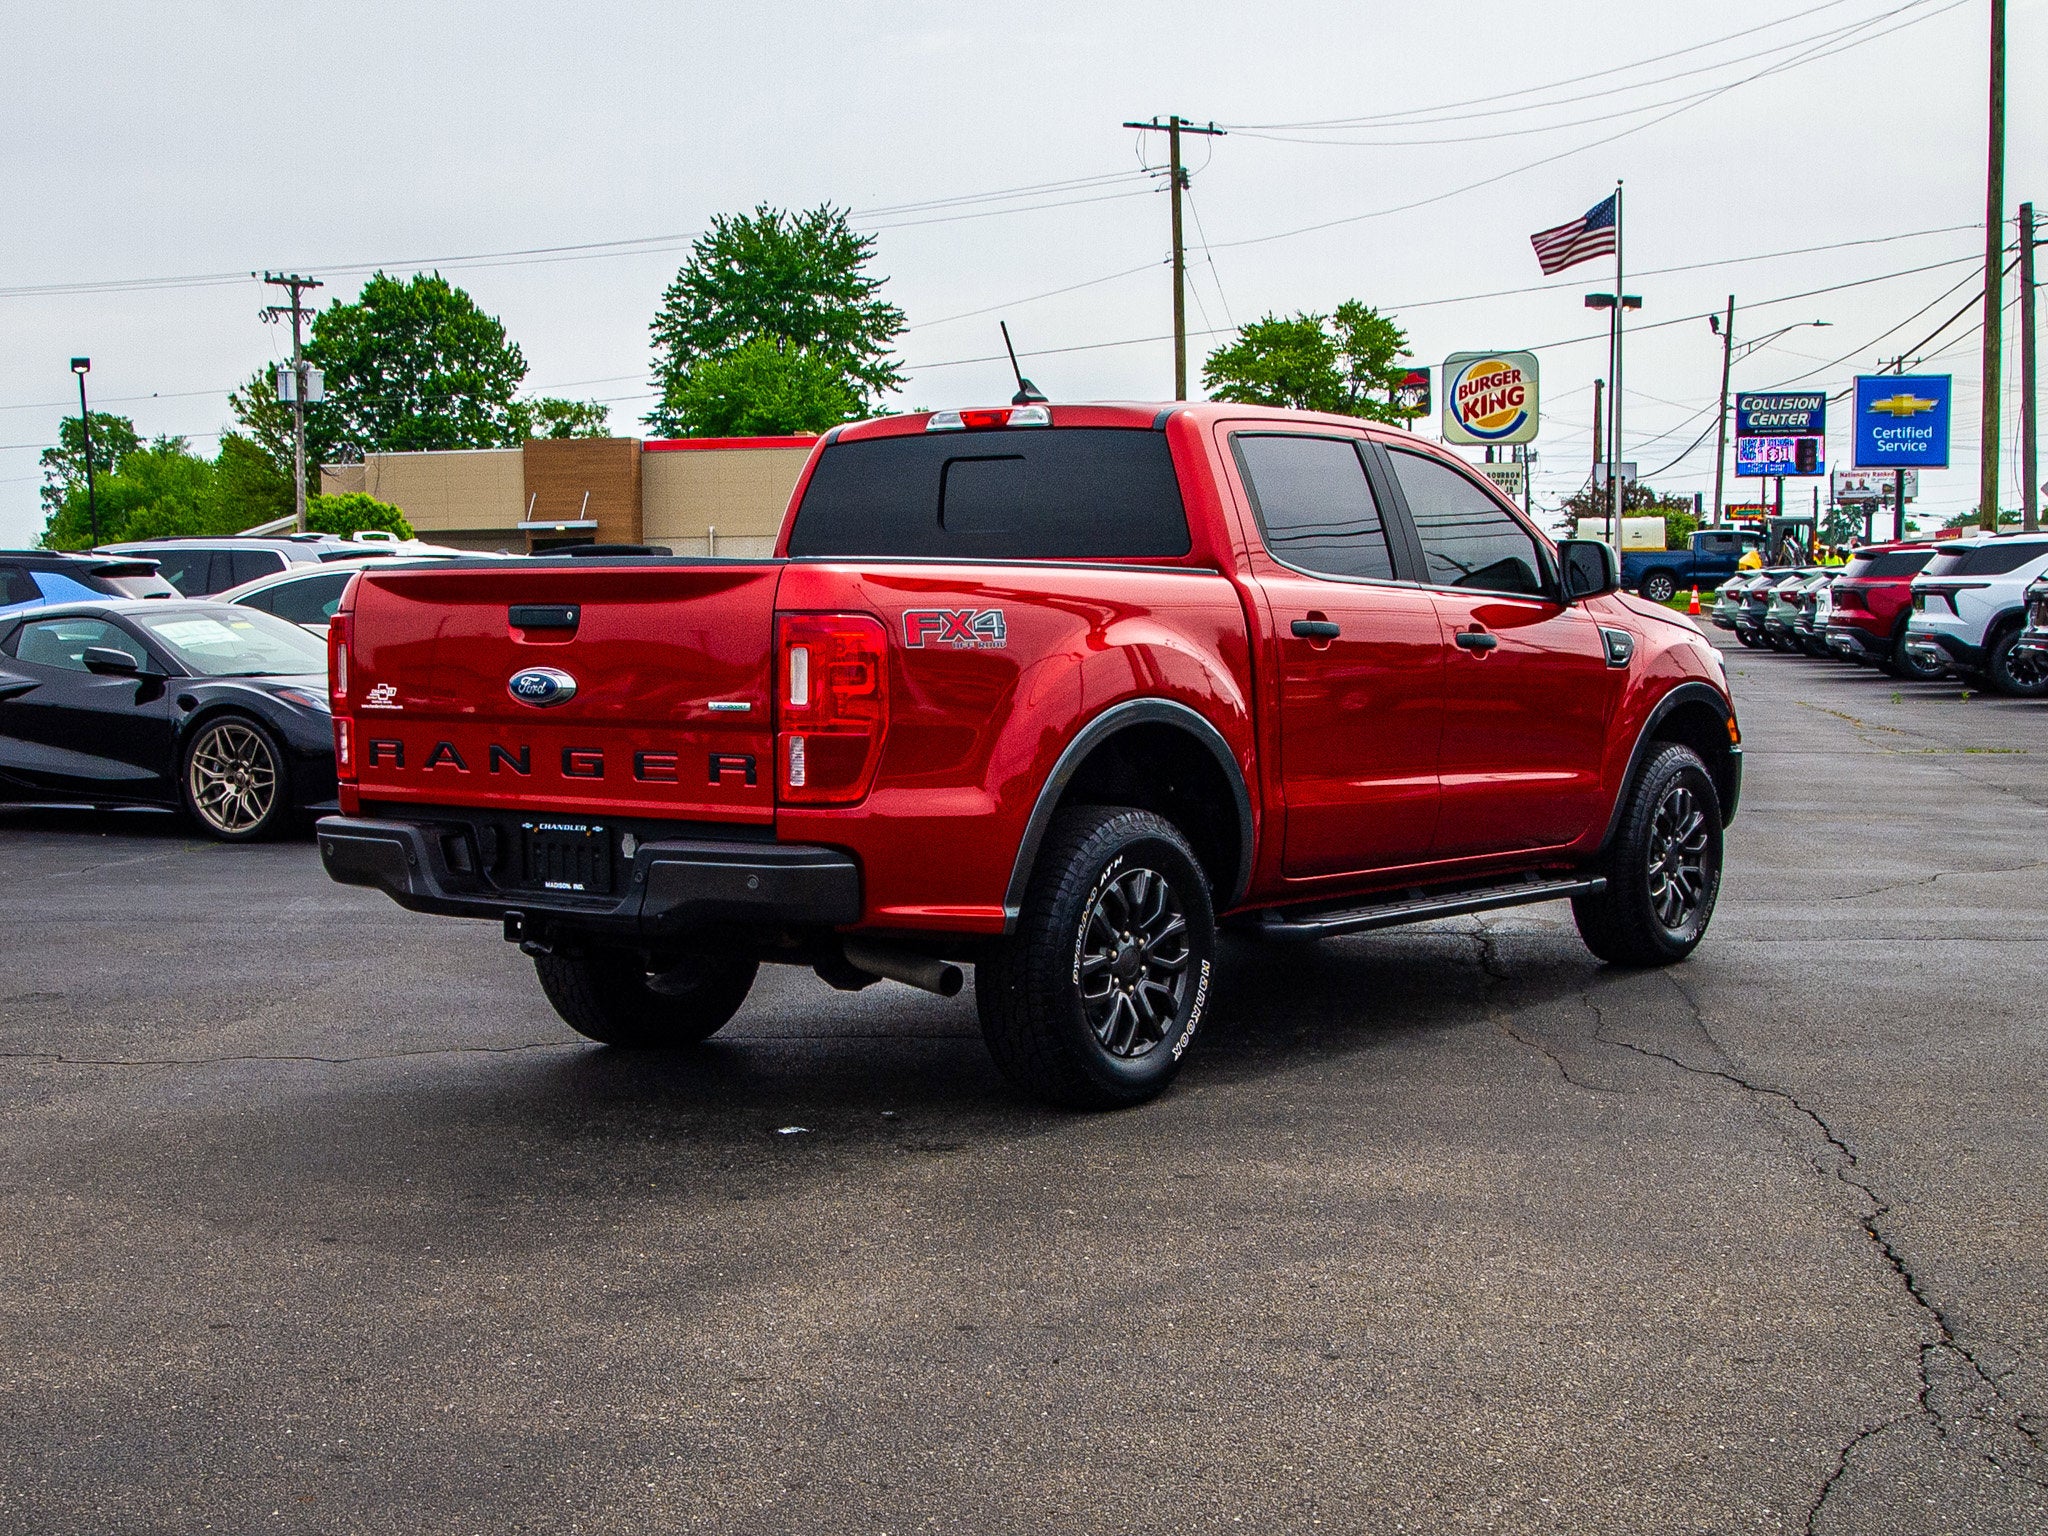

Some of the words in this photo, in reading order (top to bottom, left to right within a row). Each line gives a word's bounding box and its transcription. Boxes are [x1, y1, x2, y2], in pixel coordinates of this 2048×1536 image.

[1458, 369, 1522, 401] BURGER
[1463, 386, 1525, 423] KING
[1741, 397, 1821, 411] COLLISION
[1748, 413, 1809, 426] CENTER
[1872, 426, 1933, 439] Certified
[1877, 440, 1928, 452] Service
[902, 609, 1007, 649] FX4
[518, 676, 547, 695] Ford
[369, 740, 758, 788] RANGER
[539, 823, 587, 832] CHANDLER
